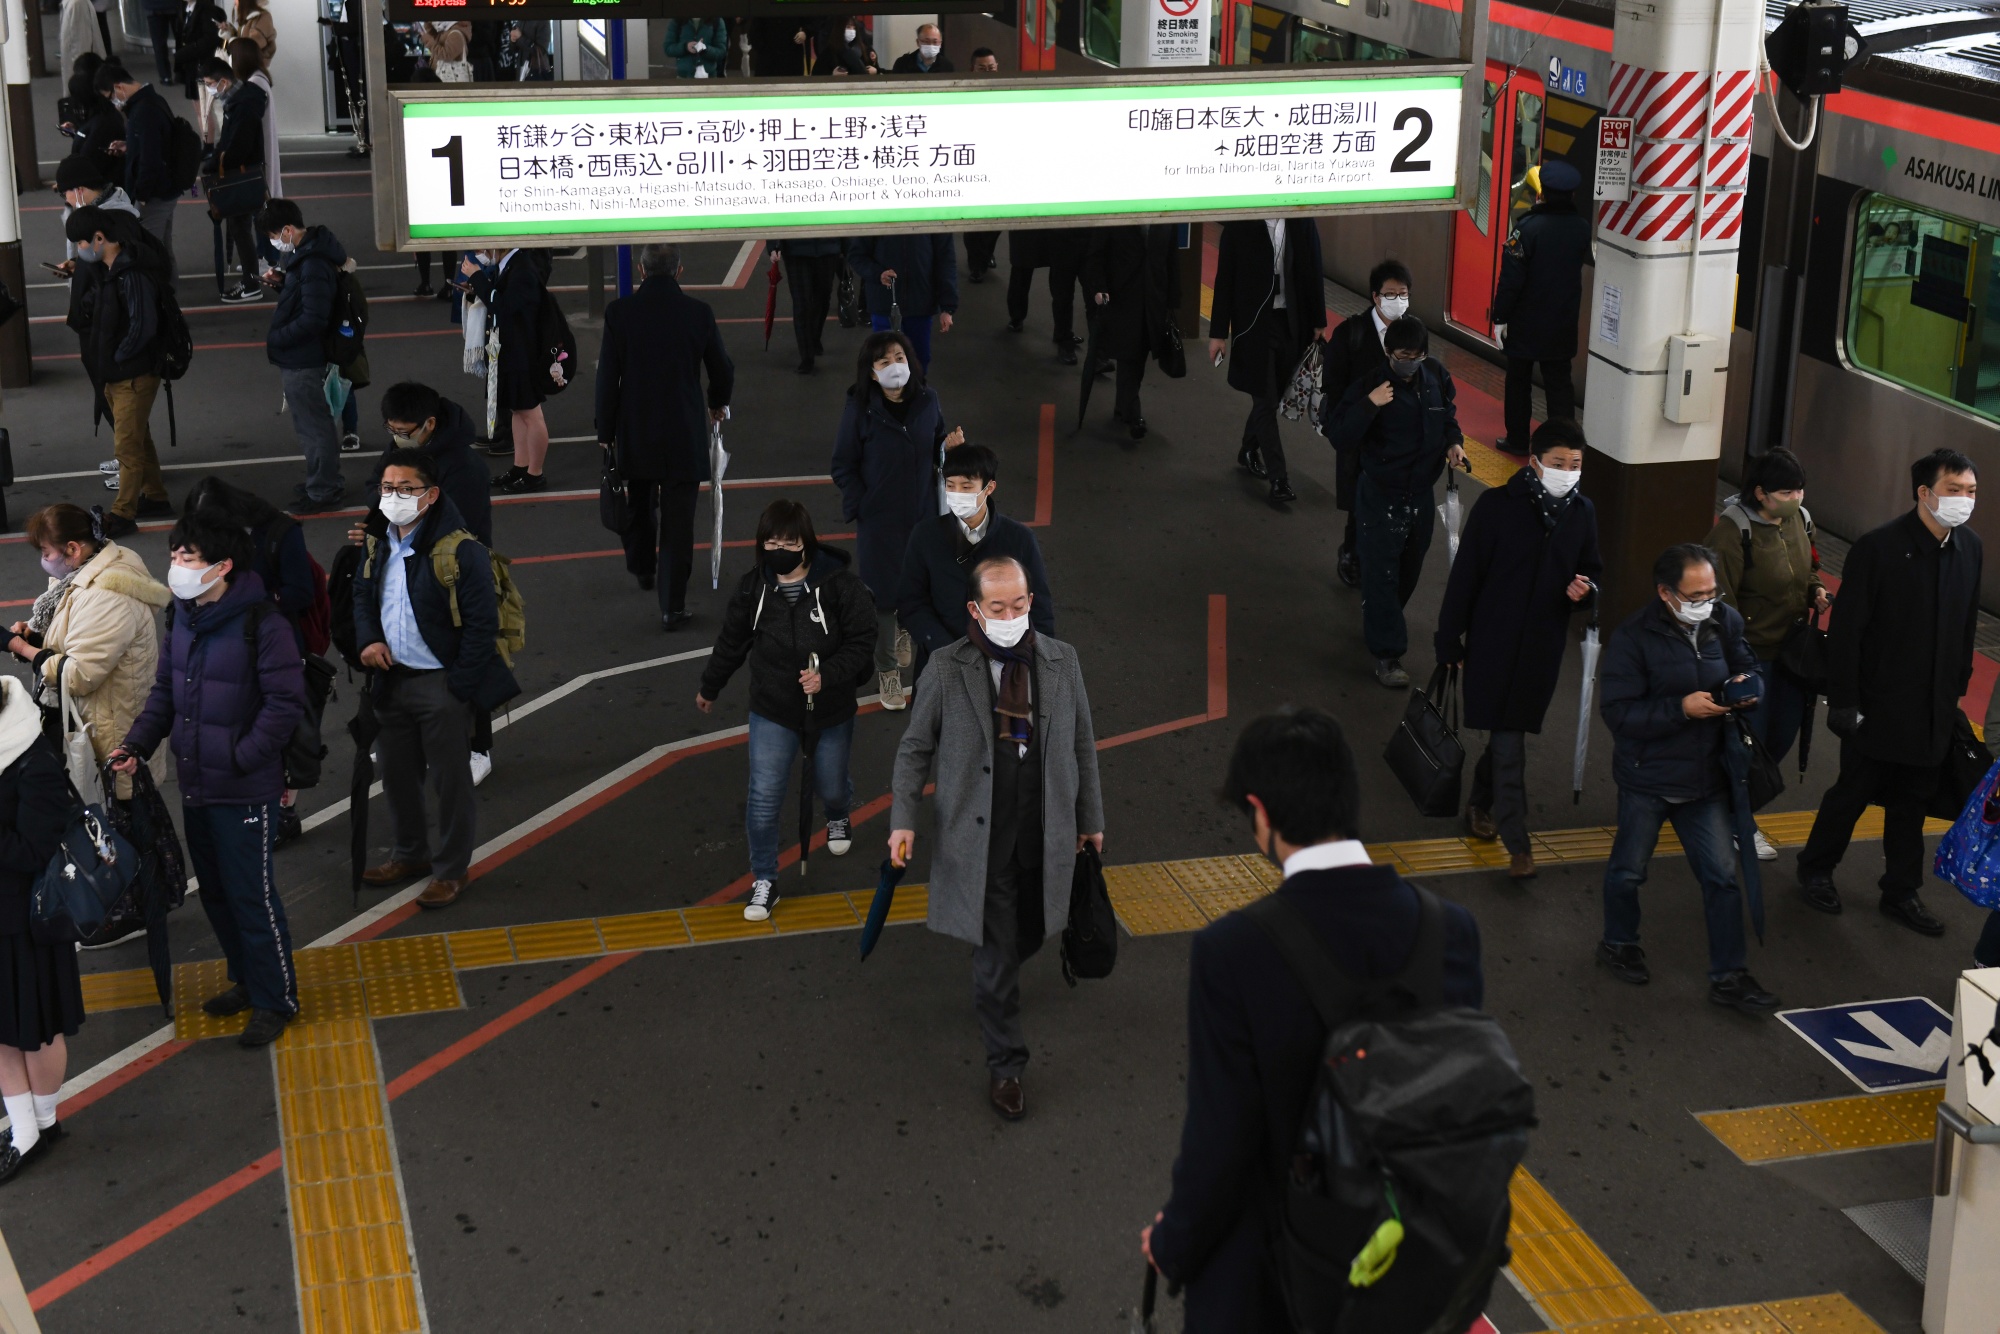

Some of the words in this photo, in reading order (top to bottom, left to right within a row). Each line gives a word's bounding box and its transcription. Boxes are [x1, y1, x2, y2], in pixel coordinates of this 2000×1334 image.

[1157, 19, 1199, 29] 終日禁煙
[1603, 121, 1629, 130] STOP
[1234, 132, 1324, 157] 成田空港
[1332, 131, 1376, 153] 方面
[1390, 107, 1434, 173] 2
[1600, 150, 1628, 158] 非常停止
[431, 135, 466, 207] 1
[1164, 165, 1181, 175] for
[1186, 164, 1215, 174] Imba
[1288, 160, 1325, 170] Narita
[1329, 158, 1375, 169] Yukawa
[1275, 175, 1283, 185] &
[1287, 174, 1324, 184] Narita
[1904, 156, 1975, 194] ASAKUSA
[499, 186, 518, 198] for
[775, 191, 825, 203] Haneda
[829, 190, 876, 202] Airport
[880, 189, 890, 200] &
